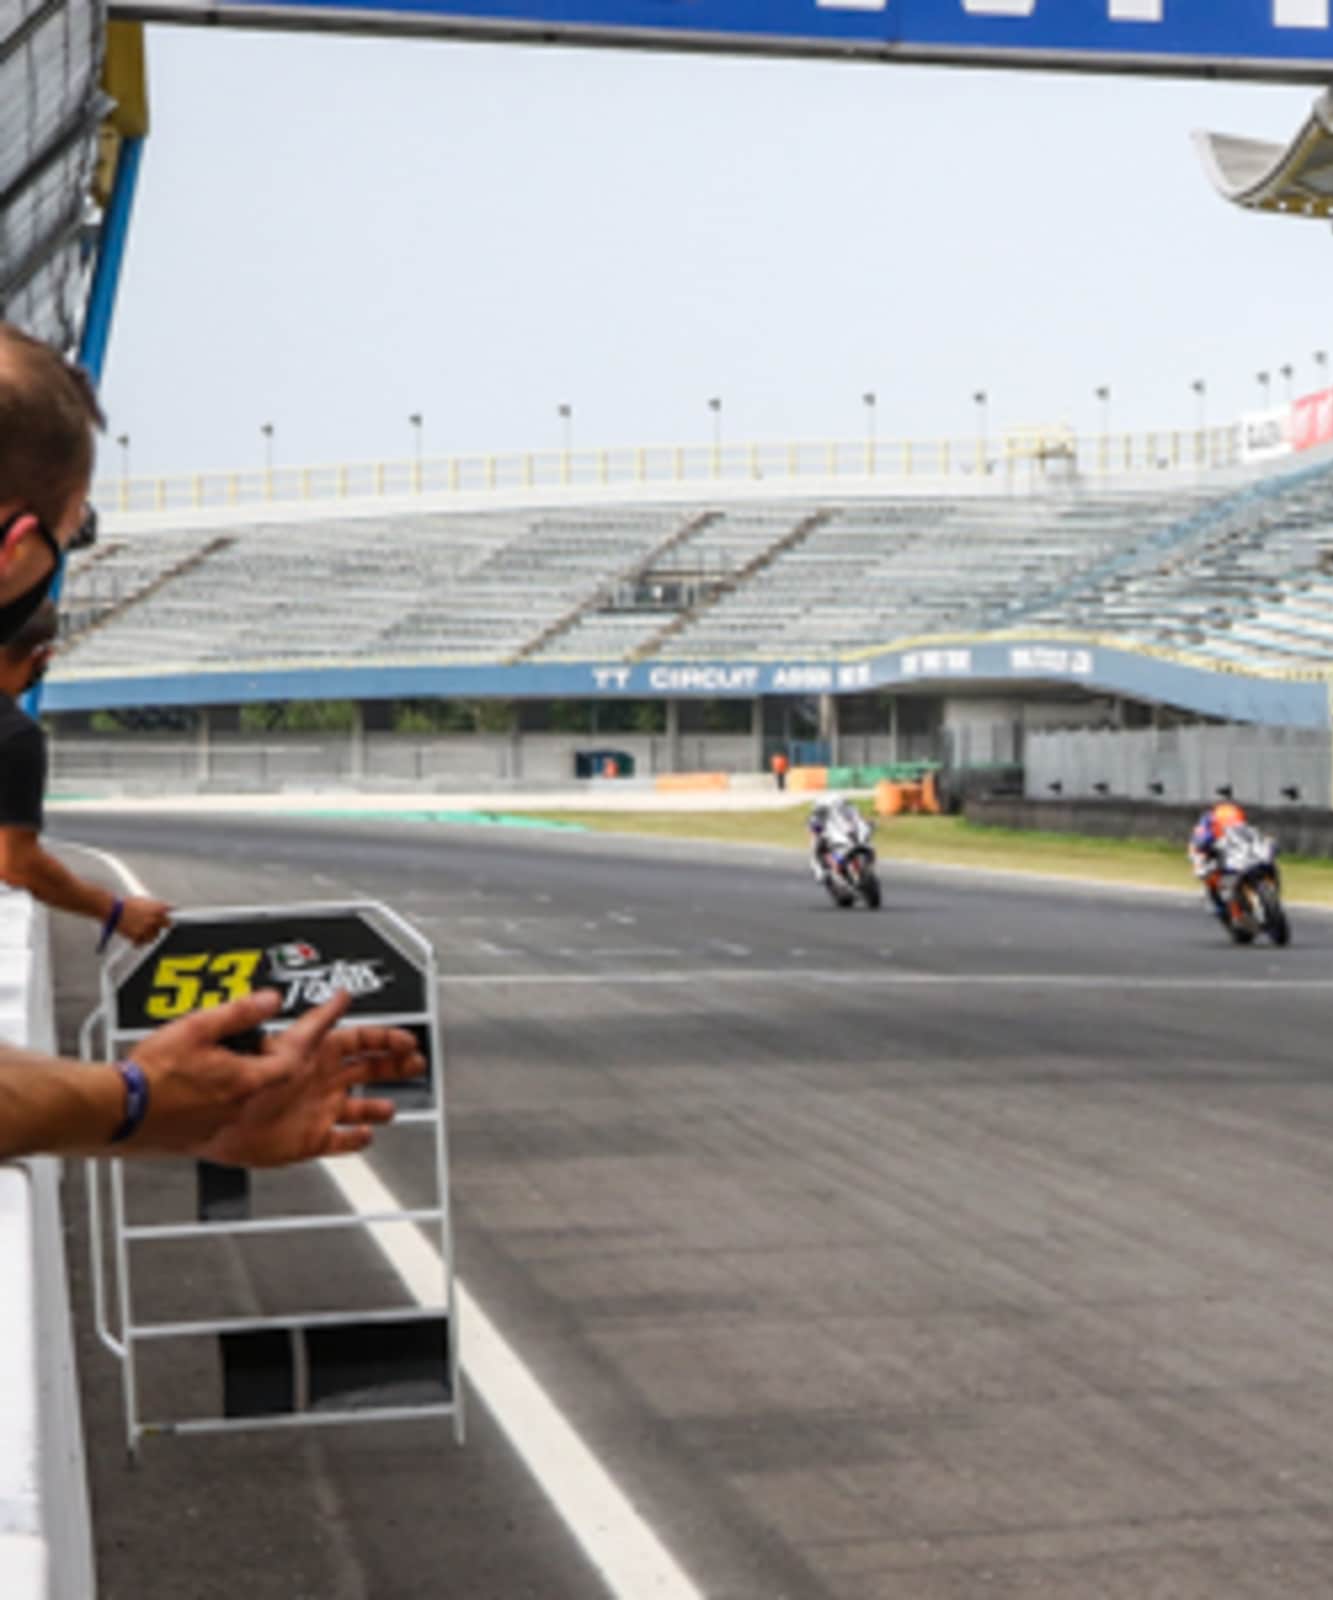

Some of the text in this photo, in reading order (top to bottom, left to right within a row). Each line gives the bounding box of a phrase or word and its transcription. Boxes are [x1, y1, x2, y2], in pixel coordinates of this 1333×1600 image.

[591, 666, 632, 689] TT
[650, 666, 760, 689] CIRCUIT
[146, 950, 262, 1018] 53
